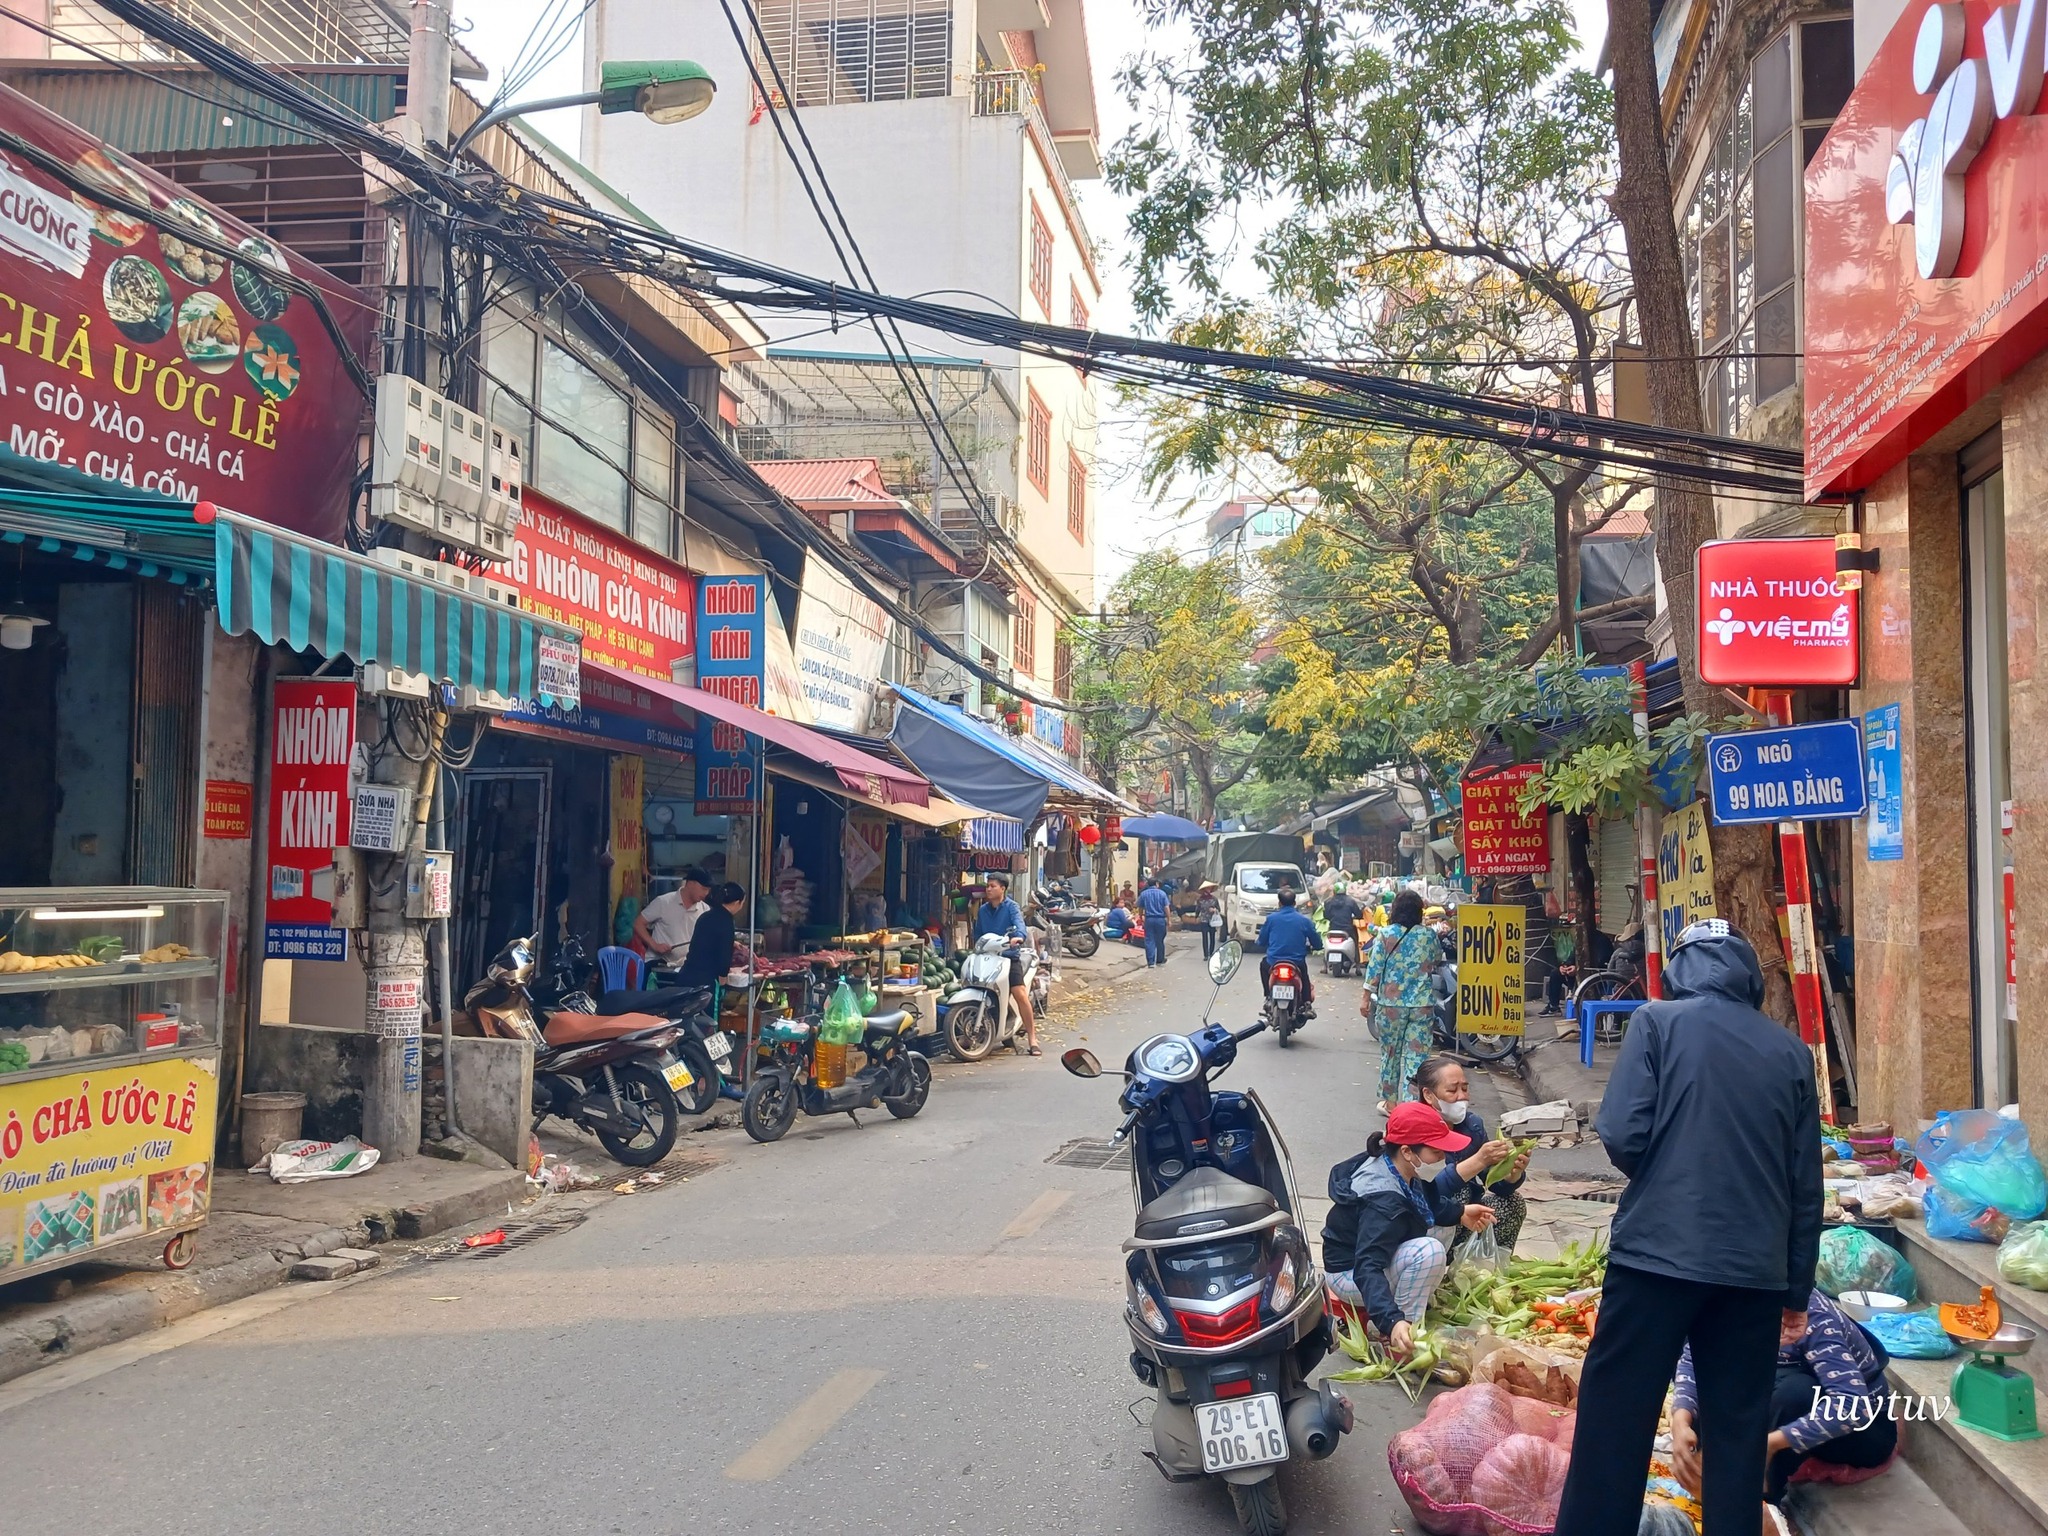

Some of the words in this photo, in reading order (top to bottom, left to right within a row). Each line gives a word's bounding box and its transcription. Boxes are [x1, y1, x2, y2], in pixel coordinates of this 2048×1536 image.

[0, 189, 79, 251] CƯỜNG
[113, 342, 221, 428] ƯỚC
[229, 388, 281, 450] LỄ
[34, 381, 84, 421] GIÒ
[90, 400, 145, 443] XÀO
[165, 431, 211, 469] CHẢ
[217, 450, 245, 481] CÁ
[537, 516, 570, 545] XUẤT
[573, 530, 604, 562] NHÔM
[606, 546, 632, 574] KÍNH
[634, 560, 658, 586] MINH
[659, 572, 678, 599] TRỤ
[536, 549, 600, 611] NHÔM
[606, 576, 643, 630] CỬA
[648, 593, 688, 645] KÍNH
[706, 580, 755, 615] NHÔM
[1710, 577, 1759, 598] NHÀ
[1765, 577, 1845, 598] THUỐC
[617, 633, 626, 647] 55
[710, 627, 752, 661] KÍNH
[1793, 638, 1850, 647] PHARMACY
[276, 694, 349, 766] NHÔM
[590, 715, 601, 730] HN
[1757, 739, 1792, 764] NGÕ
[707, 763, 752, 798] PHÁP
[1728, 784, 1749, 811] 99
[1753, 781, 1789, 809] HOA
[1792, 769, 1844, 806] BẰNG
[358, 790, 375, 807] SỬA
[377, 794, 396, 810] NHÀ
[1466, 785, 1502, 800] GIẶT
[229, 804, 241, 814] GIA
[280, 778, 338, 849] KÍNH
[1478, 800, 1498, 814] LÀ
[227, 820, 246, 831] PCCC
[1468, 818, 1505, 834] GIẶT
[1471, 833, 1503, 850] SẤY
[1508, 834, 1543, 848] KHÔ
[1660, 815, 1680, 884] PHỞ
[1478, 851, 1501, 863] LẤY
[1505, 852, 1536, 863] NGAY
[1688, 890, 1715, 910] Chả
[282, 928, 294, 938] 102
[295, 926, 308, 938] PHỐ
[309, 929, 323, 939] HOA
[1462, 911, 1497, 965] PHỞ
[1505, 922, 1521, 941] Bò
[283, 941, 305, 954] 0986
[306, 942, 323, 955] 663
[325, 943, 342, 955] 228
[1505, 946, 1520, 964] Gà
[1503, 974, 1521, 989] Chả
[1461, 977, 1493, 1017] BÚN
[1502, 992, 1522, 1005] Nem
[1503, 1007, 1521, 1022] Đậu
[32, 1080, 92, 1145] CHẢ
[101, 1078, 160, 1126] ƯỚC
[163, 1081, 197, 1135] LỄ
[1, 1171, 41, 1194] Đậm
[46, 1161, 70, 1184] đà
[71, 1156, 119, 1178] hương
[122, 1146, 137, 1169] vị
[141, 1139, 173, 1163] Việt
[1207, 1399, 1270, 1436] 29-E1
[1206, 1428, 1282, 1467] 906.16
